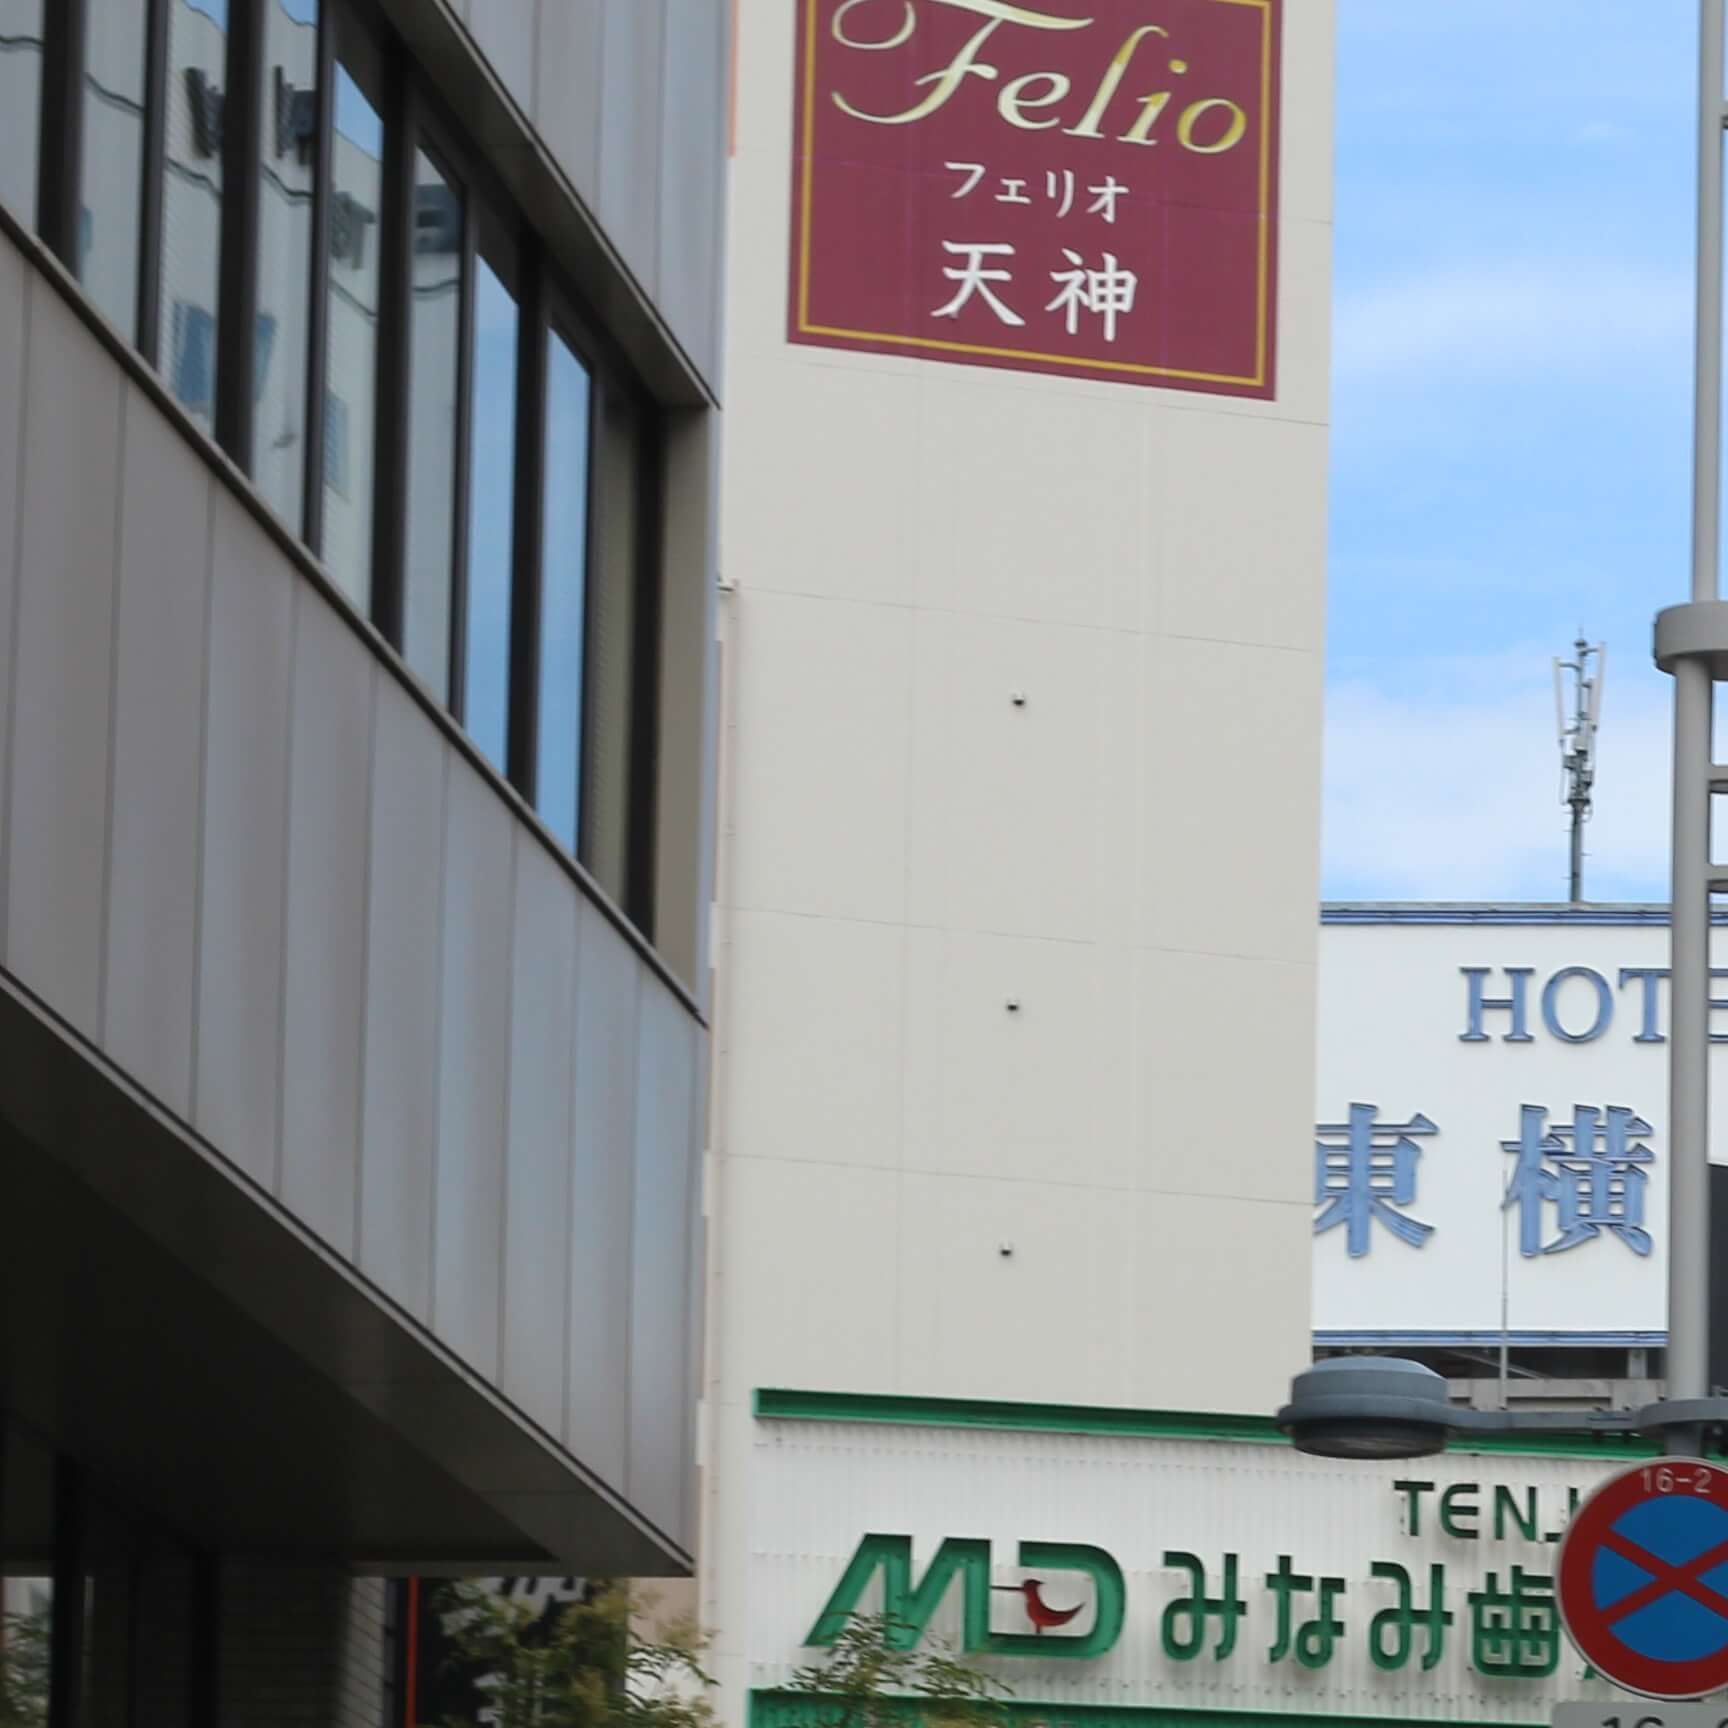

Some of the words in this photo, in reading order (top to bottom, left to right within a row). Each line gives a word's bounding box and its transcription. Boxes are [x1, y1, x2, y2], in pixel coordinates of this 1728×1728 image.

[831, 0, 1247, 153] Felio
[944, 160, 1130, 223] フェリオ
[930, 239, 1138, 342] 天神
[1394, 1480, 1577, 1541] TENJ
[1642, 1466, 1712, 1494] 16-2
